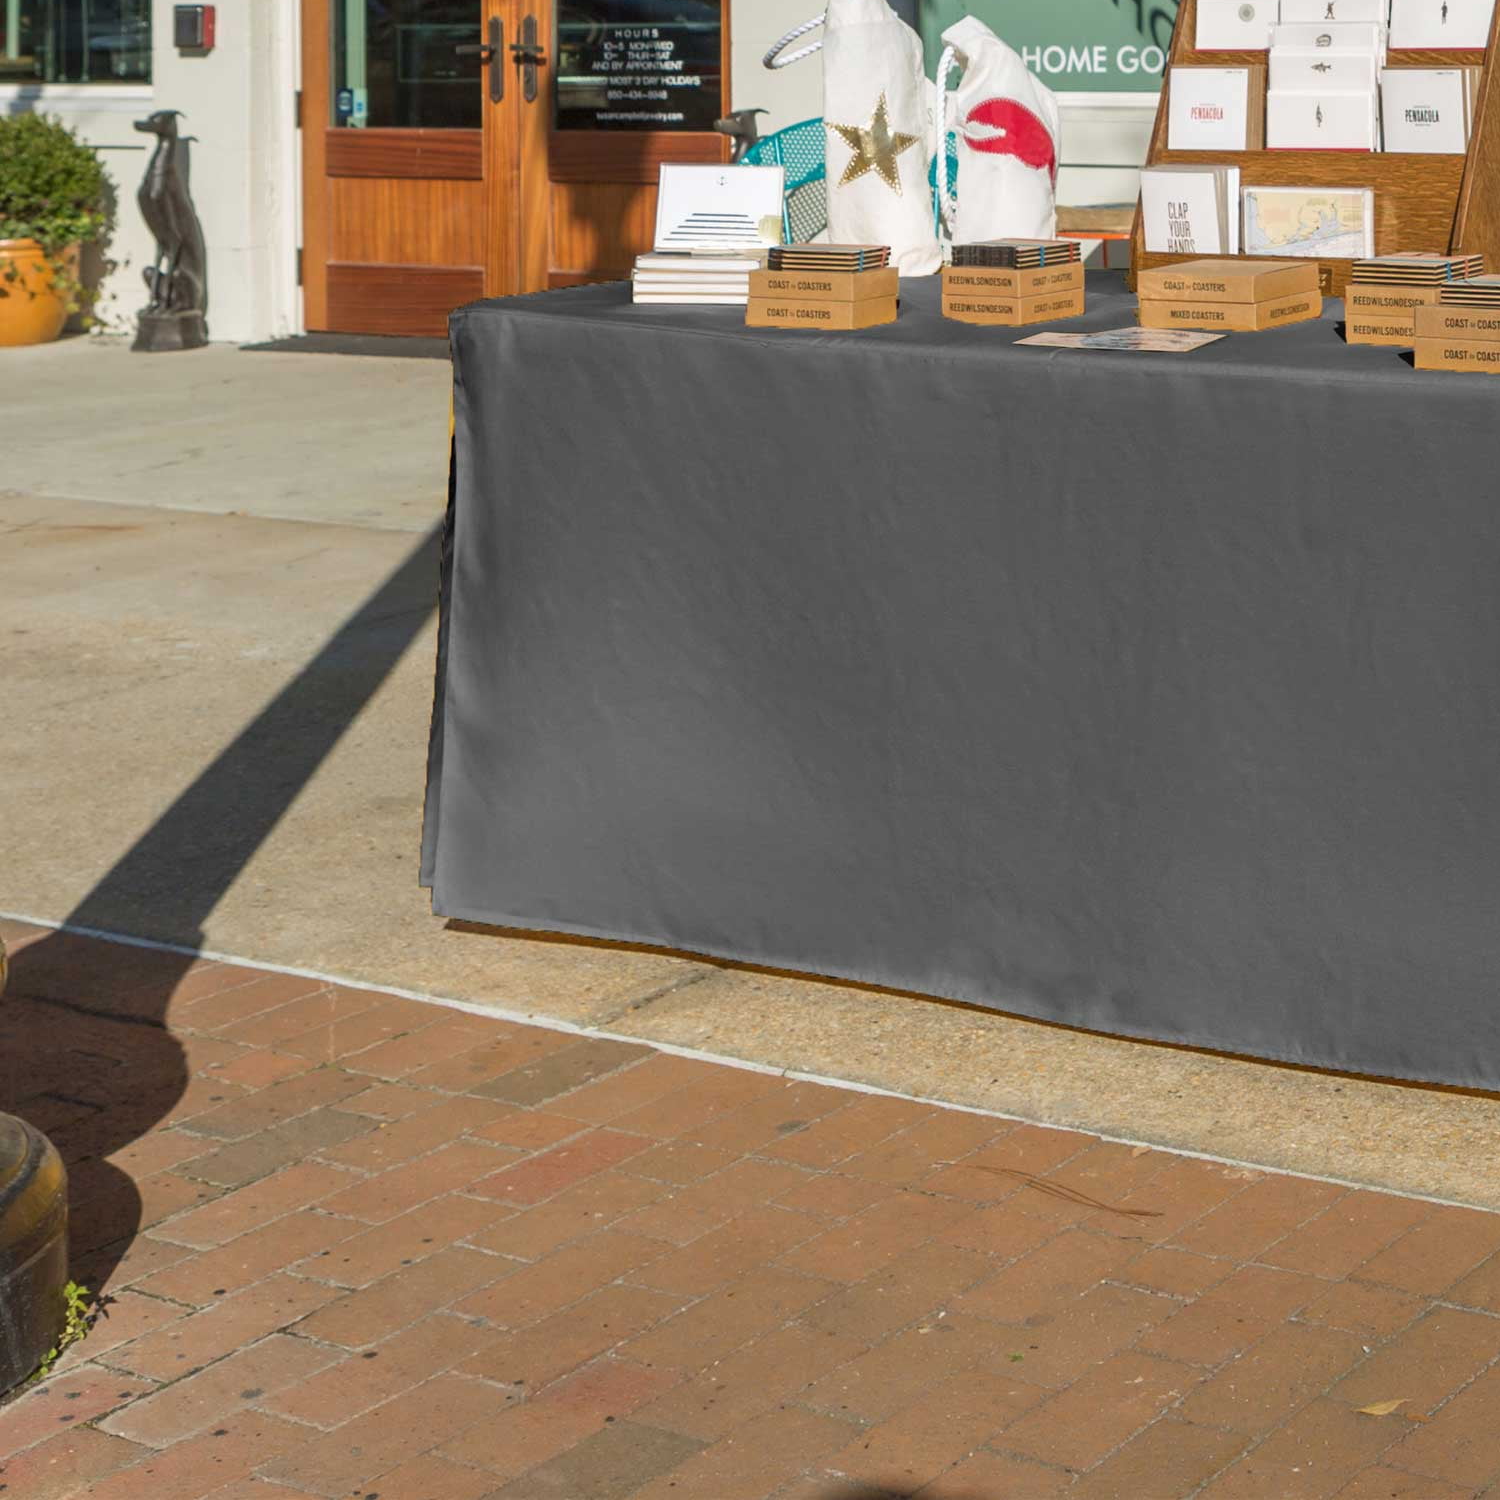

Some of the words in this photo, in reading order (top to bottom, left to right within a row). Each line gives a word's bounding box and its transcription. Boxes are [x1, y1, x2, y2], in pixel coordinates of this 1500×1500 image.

[614, 28, 659, 38] HOURS
[1022, 45, 1106, 73] HOME
[1116, 45, 1169, 73] GO
[592, 61, 609, 71] AND
[626, 60, 683, 70] APPOINTMENT
[661, 75, 701, 86] HOLIDAYS
[1190, 107, 1224, 120] PENSACOLA
[1405, 109, 1440, 122] PENSACOLA
[1167, 202, 1188, 219] CLAP
[1168, 220, 1191, 237] YOUR
[768, 280, 790, 289] COAST
[797, 281, 832, 291] COASTERS
[1164, 281, 1185, 290] COAST
[1192, 281, 1226, 292] COASTERS
[767, 308, 788, 317] COAST
[796, 309, 831, 319] COASTERS
[1170, 310, 1191, 319] MIXED
[1192, 311, 1225, 321] COASTERS
[1445, 318, 1468, 328] COAST
[1444, 350, 1467, 360] COAST
